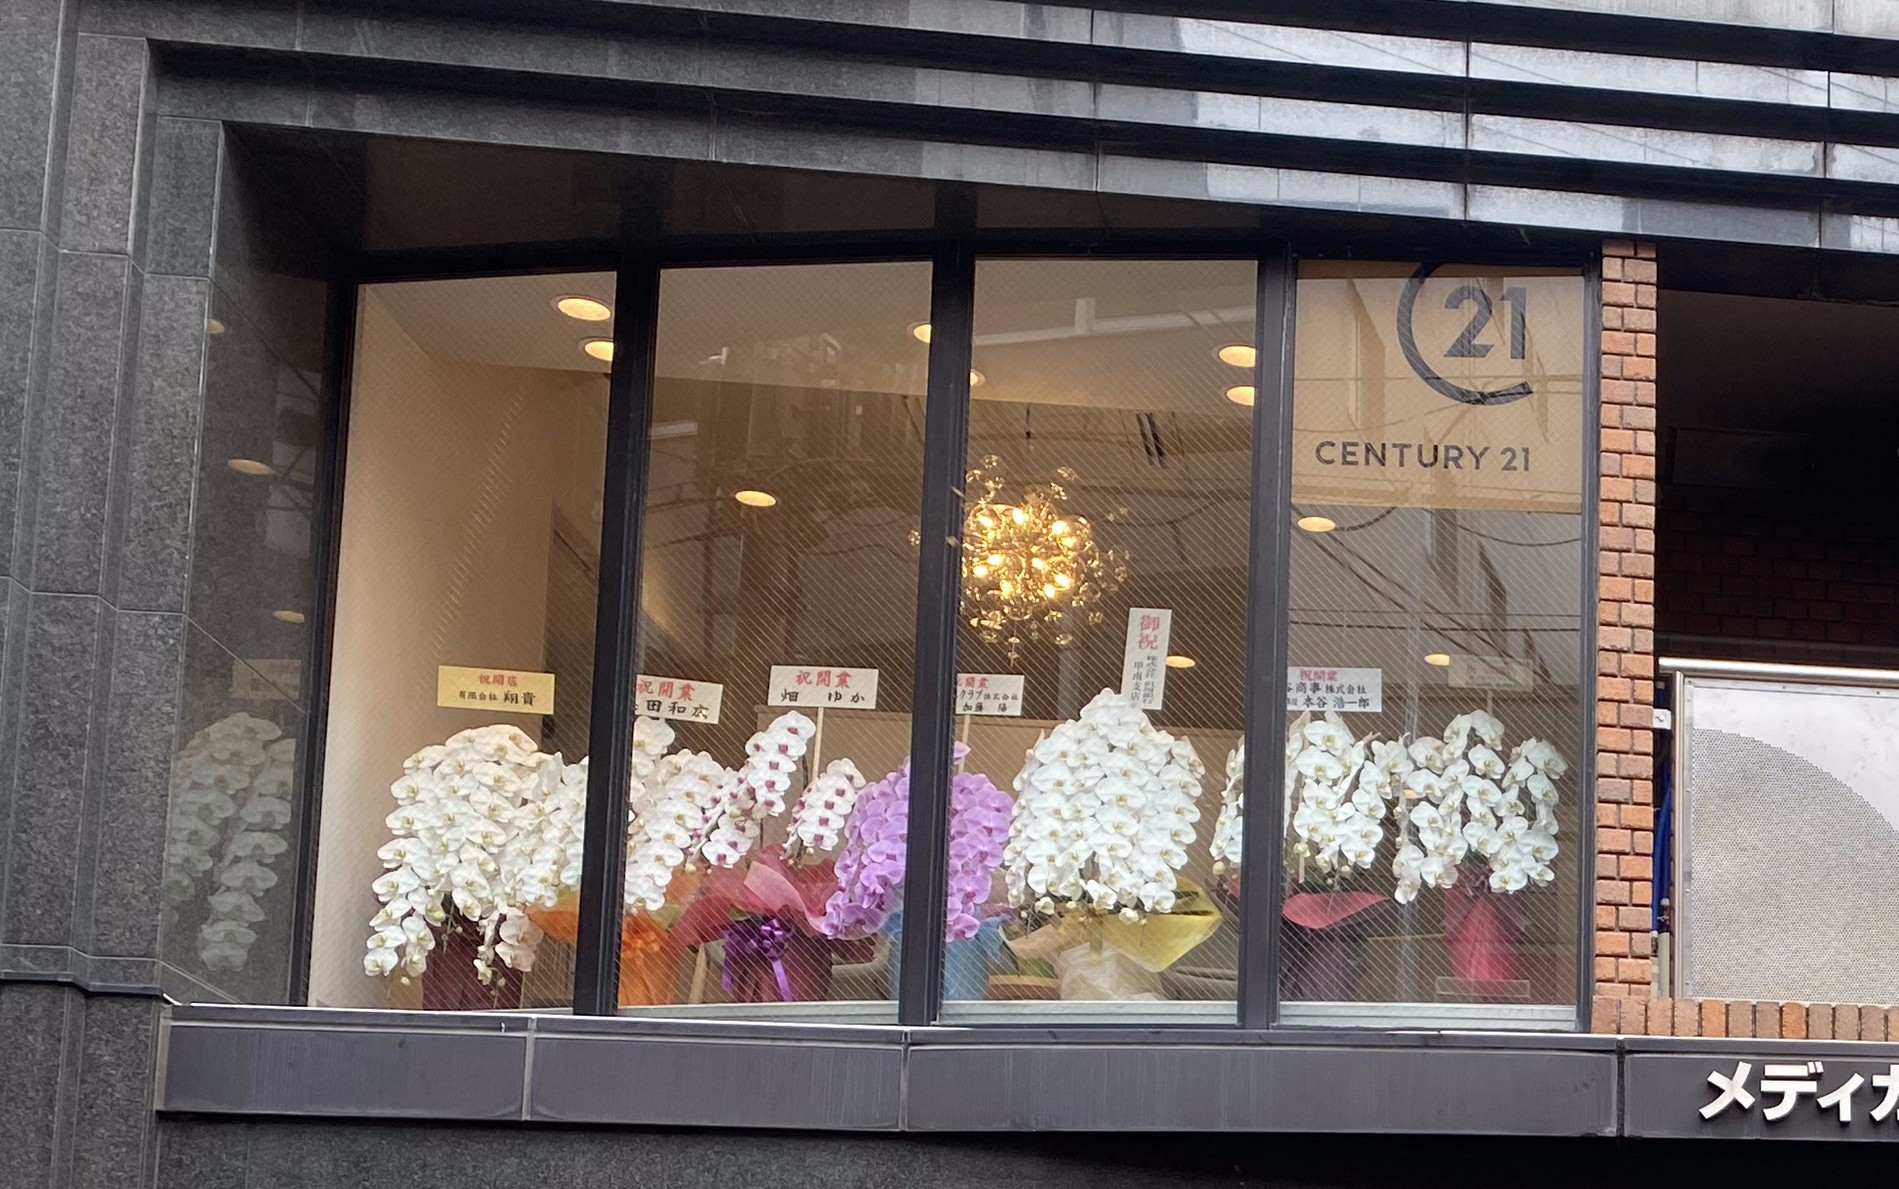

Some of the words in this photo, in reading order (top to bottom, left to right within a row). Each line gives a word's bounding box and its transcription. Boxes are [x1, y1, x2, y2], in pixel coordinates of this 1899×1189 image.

[1315, 441, 1490, 470] CENTURY
[1500, 447, 1530, 471] 21
[795, 670, 852, 689] 祝開業
